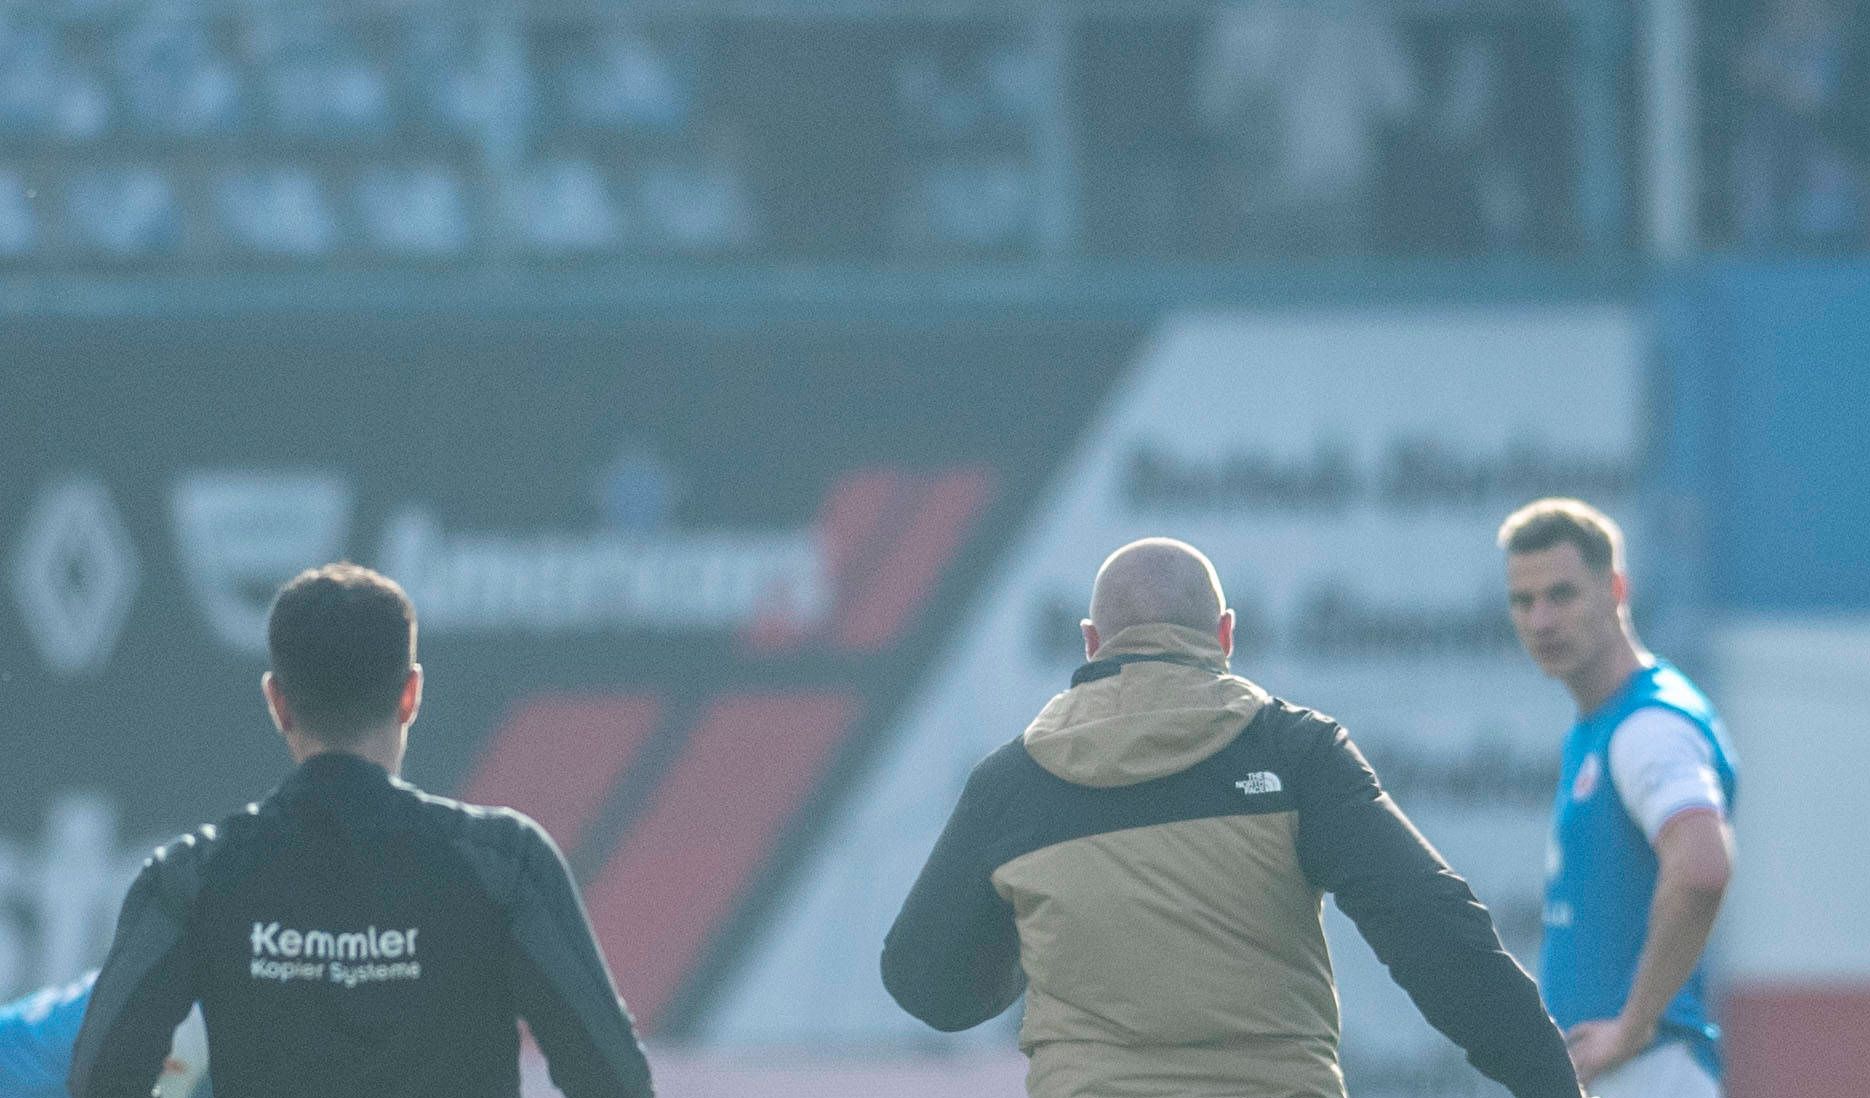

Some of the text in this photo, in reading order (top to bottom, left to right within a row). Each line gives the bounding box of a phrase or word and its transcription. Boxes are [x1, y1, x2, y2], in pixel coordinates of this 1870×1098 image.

[250, 921, 418, 961] Kemmler
[250, 959, 421, 988] Kopier Systeme
